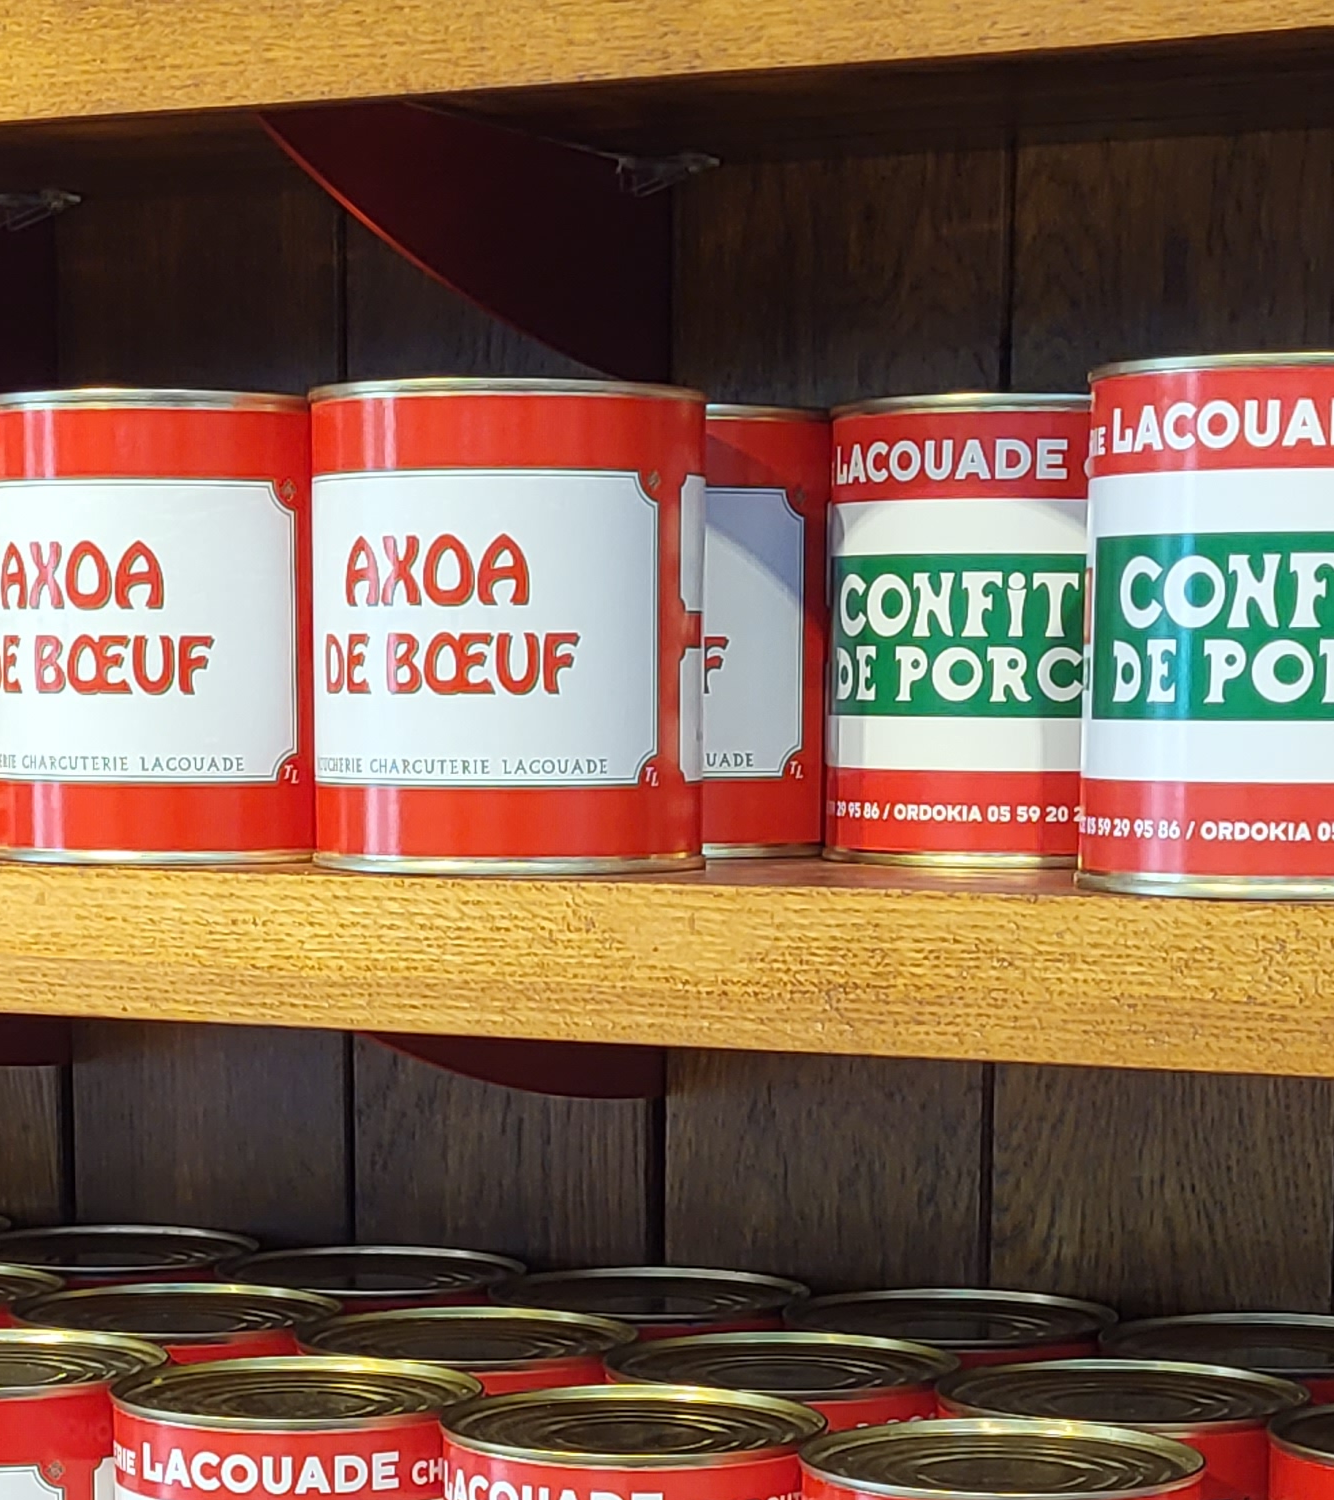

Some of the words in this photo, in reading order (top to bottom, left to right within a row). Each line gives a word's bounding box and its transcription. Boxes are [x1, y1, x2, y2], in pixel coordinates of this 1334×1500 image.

[836, 438, 1067, 484] LACOUADE
[0, 539, 165, 610] AXOA
[345, 532, 530, 608] AXOA
[34, 634, 216, 696] BŒUF
[326, 632, 370, 696] DE
[386, 631, 581, 697] BŒUF
[836, 645, 878, 702] DE
[895, 645, 1083, 704] PORC
[1112, 638, 1177, 704] DE
[370, 756, 491, 776] CHARCUTERIE
[502, 757, 609, 777] LACOUADE
[141, 1440, 400, 1496] LACOUADE
